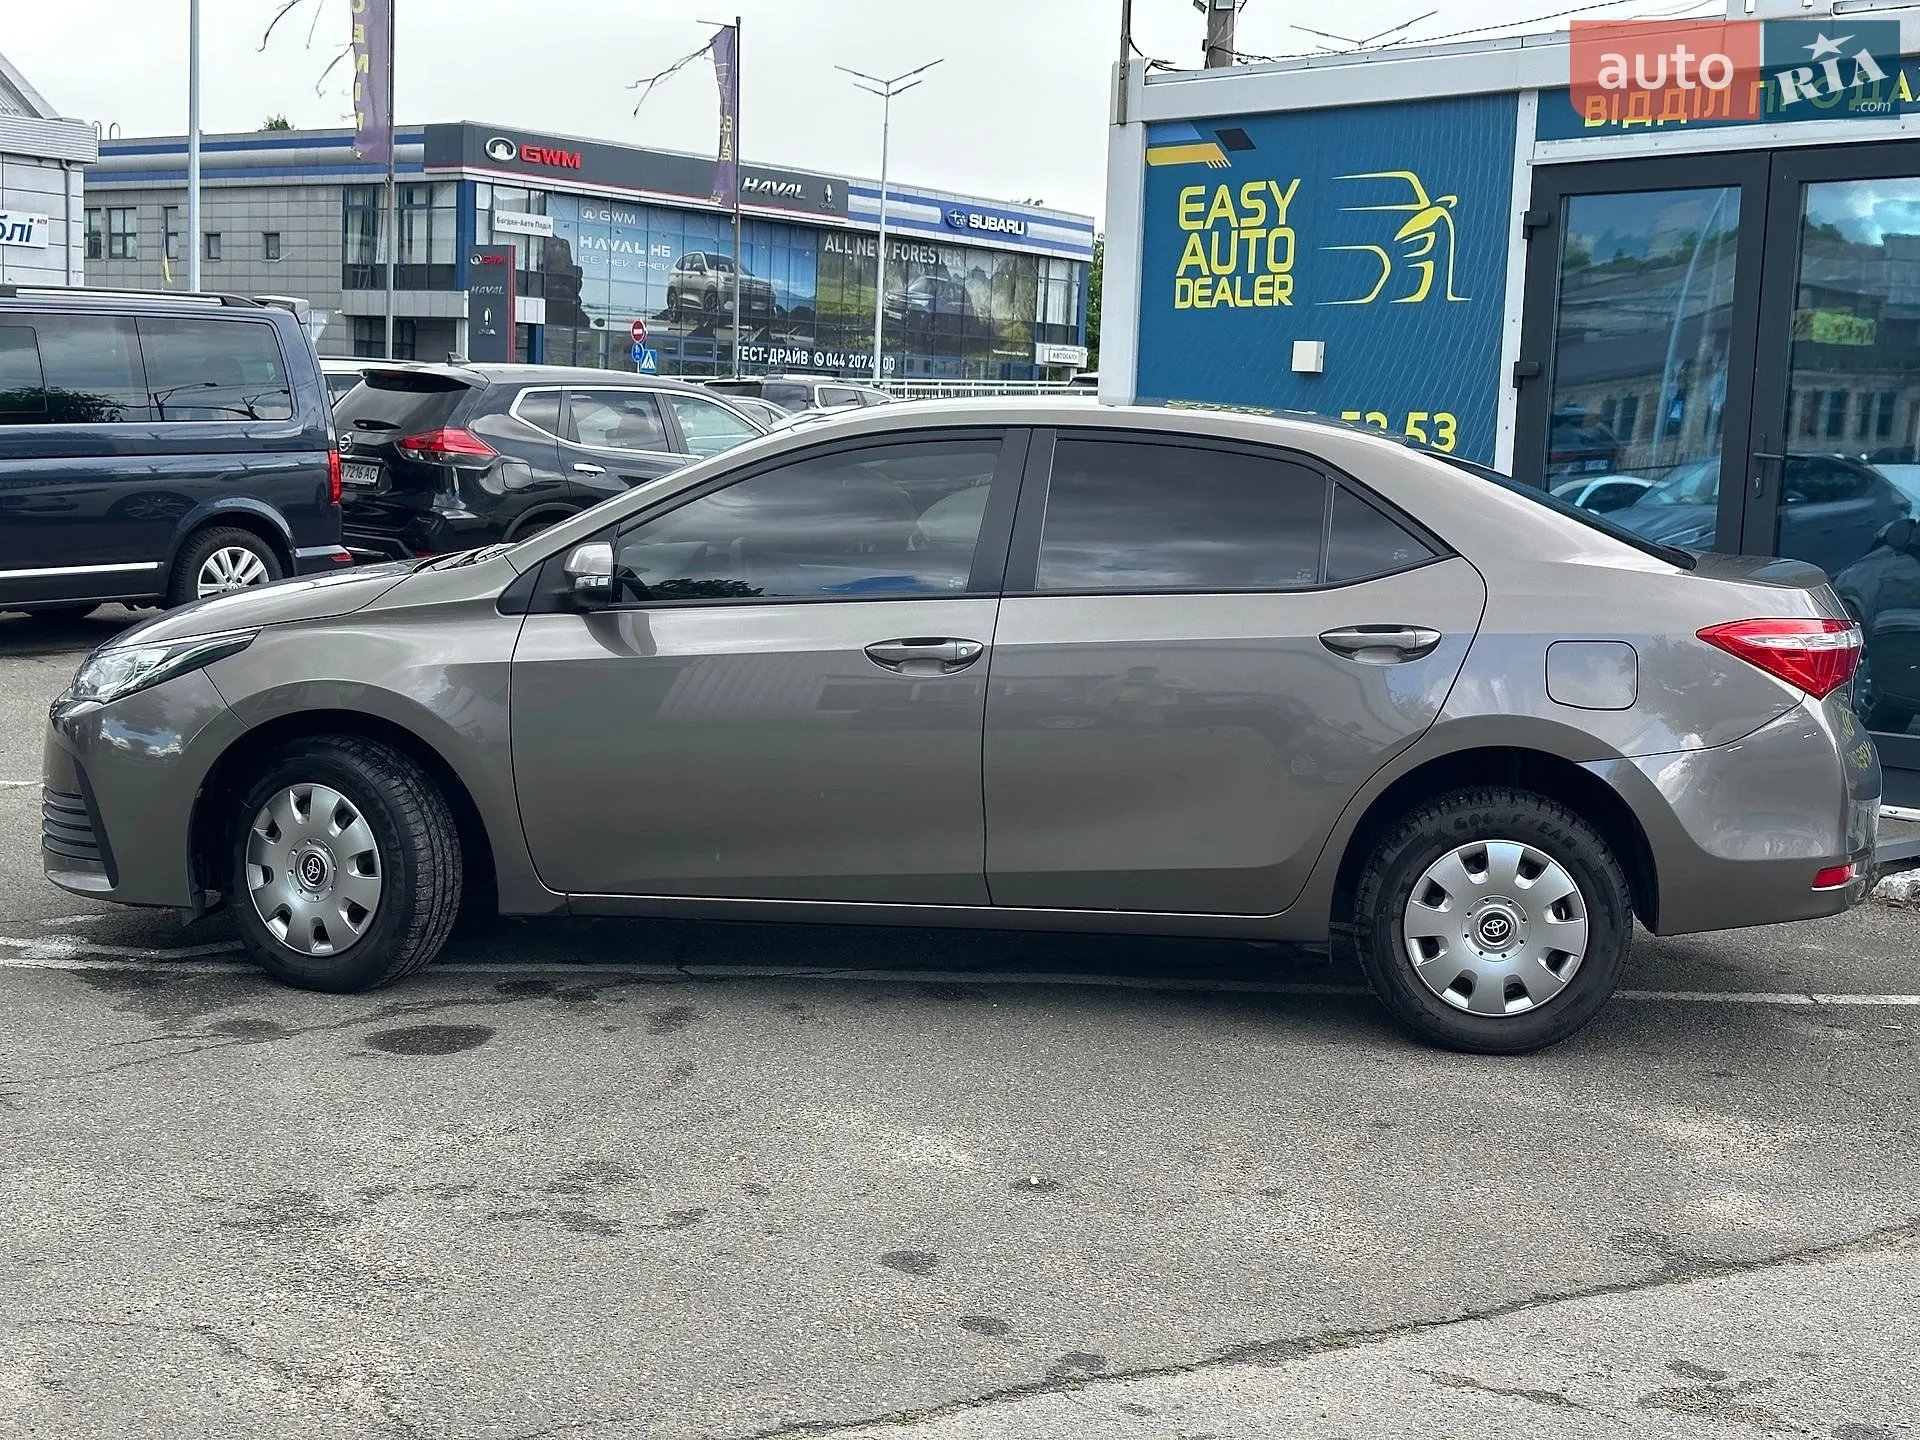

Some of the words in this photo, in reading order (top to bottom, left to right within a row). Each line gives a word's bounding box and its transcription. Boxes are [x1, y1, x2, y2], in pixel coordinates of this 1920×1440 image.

[1584, 83, 1732, 128] ВІДДІЛ
[1748, 67, 1920, 115] ПРОДА
[520, 144, 581, 169] GWM
[741, 177, 807, 199] HAVAL
[599, 209, 637, 225] GWM
[1178, 178, 1302, 231] EASY
[968, 213, 1025, 235] SUBARU
[579, 235, 646, 255] HAVAL
[650, 243, 671, 258] H6
[824, 233, 853, 254] ALL
[892, 242, 962, 267] FORESTER
[1176, 226, 1295, 277] AUTO
[470, 285, 505, 295] HAVAL
[1174, 273, 1294, 309] DEALER
[737, 345, 809, 365] ТЕСТ-ДРАЙВ
[826, 352, 846, 368] 044
[1404, 411, 1457, 453] 53
[345, 464, 363, 479] 7216
[363, 466, 378, 480] AC
[1453, 811, 1577, 849] GOOYEAR
